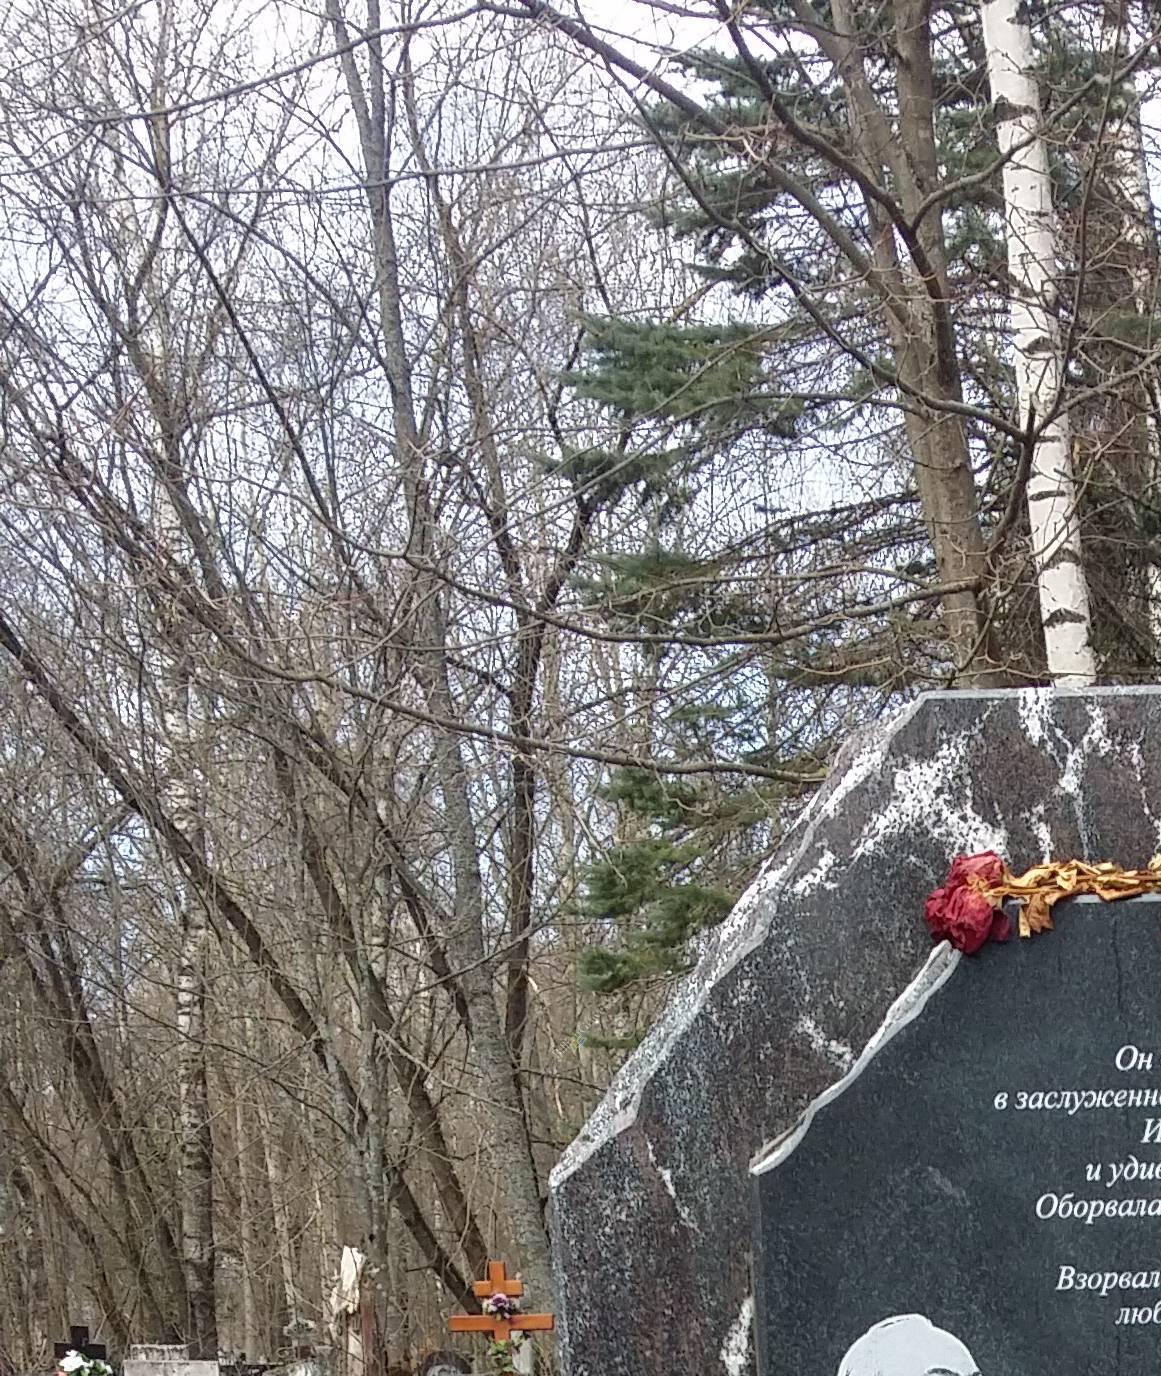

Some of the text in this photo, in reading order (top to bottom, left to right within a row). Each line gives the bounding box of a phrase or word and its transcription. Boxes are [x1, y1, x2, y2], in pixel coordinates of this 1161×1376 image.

[1115, 1044, 1152, 1071] Он
[994, 1089, 1007, 1109] в
[1086, 1162, 1101, 1181] и
